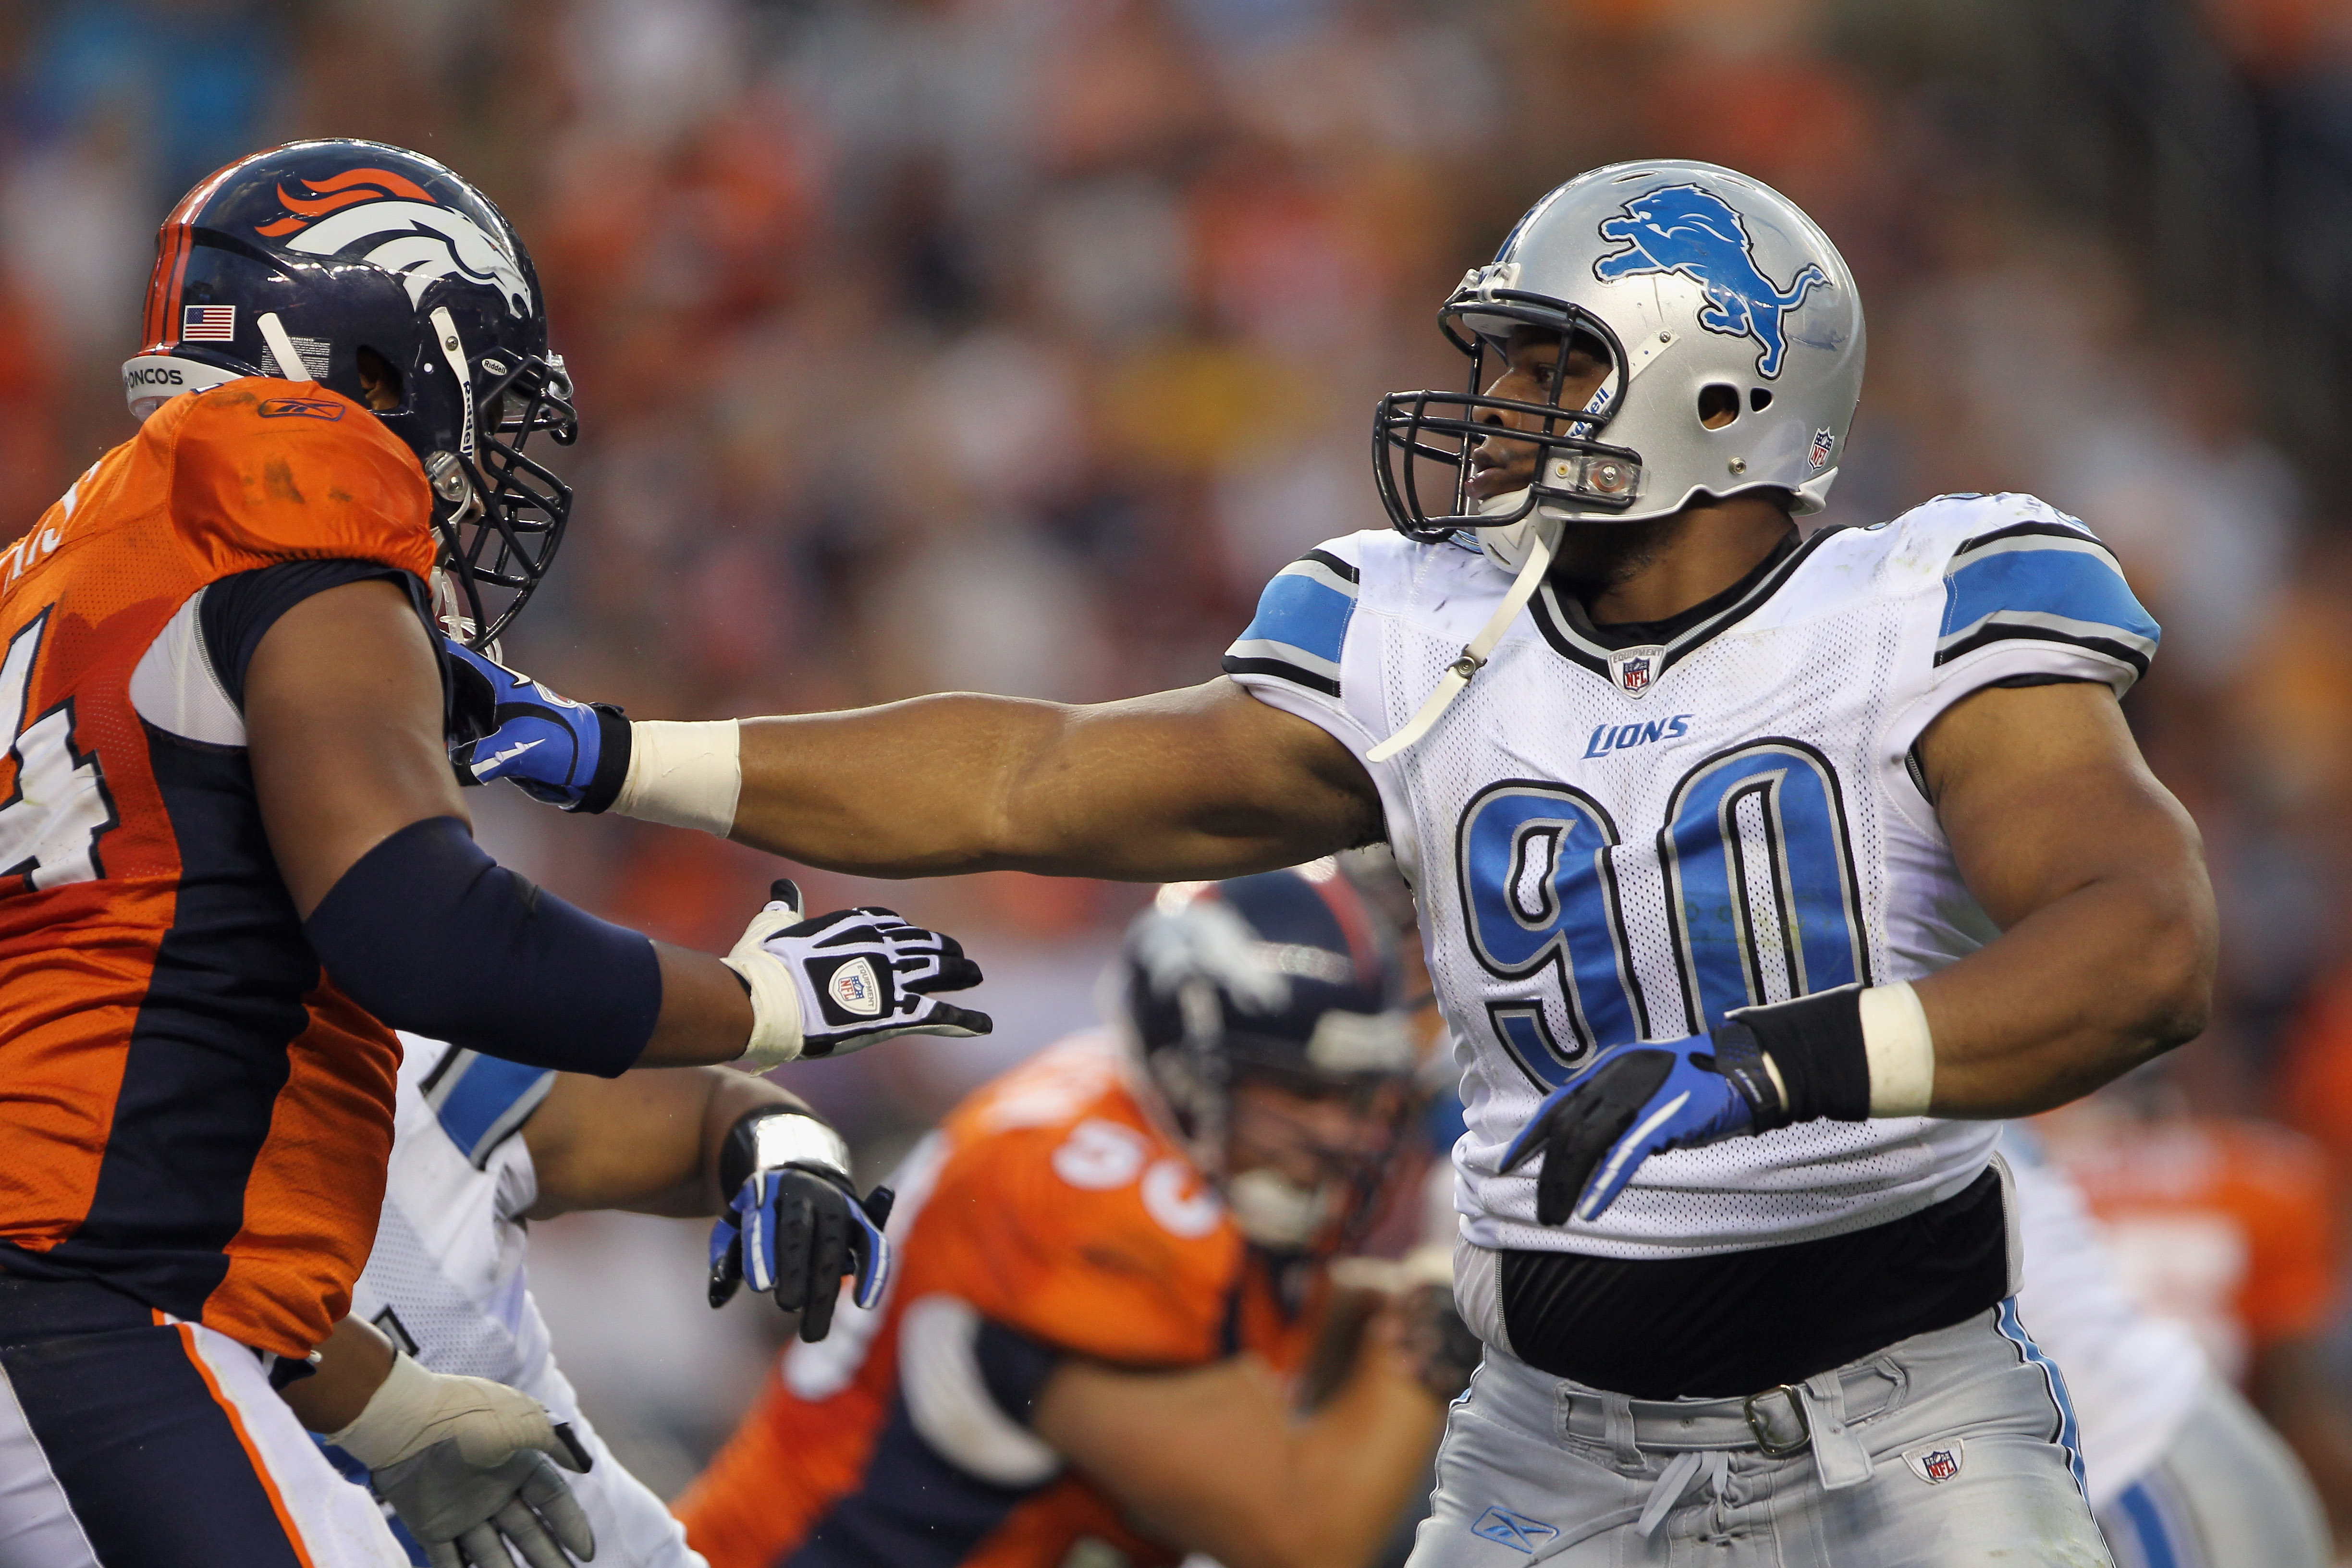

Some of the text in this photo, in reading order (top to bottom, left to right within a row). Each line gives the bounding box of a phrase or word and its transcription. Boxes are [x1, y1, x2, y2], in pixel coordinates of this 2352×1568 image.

[484, 360, 506, 374] Riddell
[1811, 444, 1827, 466] NFL
[1613, 649, 1663, 663] EQUIPMENT
[1624, 670, 1647, 687] NFL
[1580, 714, 1695, 760] LIONS
[1456, 736, 1872, 1098] 90
[840, 979, 855, 999] NFL
[857, 964, 874, 1007] EQUIPMENT
[1928, 1461, 1955, 1478] NFL
